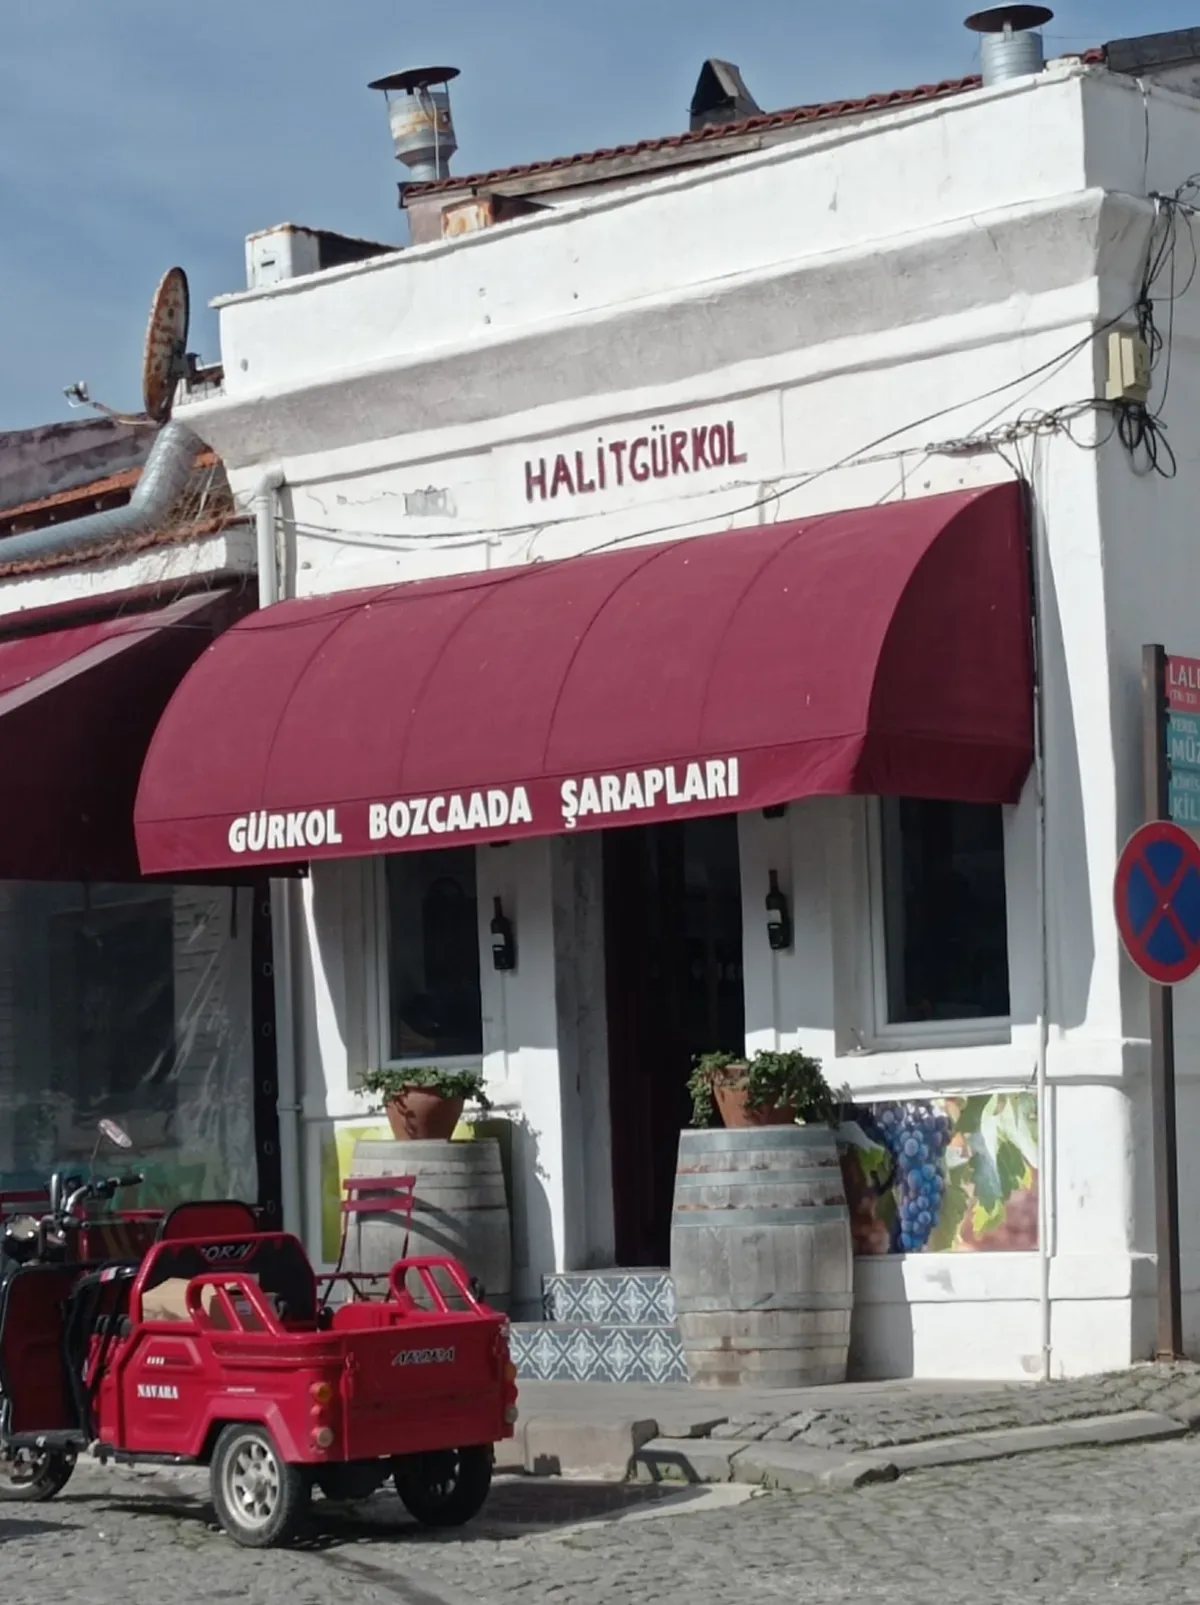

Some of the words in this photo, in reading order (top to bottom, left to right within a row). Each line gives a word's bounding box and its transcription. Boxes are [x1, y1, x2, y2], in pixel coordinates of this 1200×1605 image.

[228, 808, 342, 853] GÜRKOL
[369, 786, 532, 840] BOZCAADA
[561, 757, 739, 829] ŞARAPLARI
